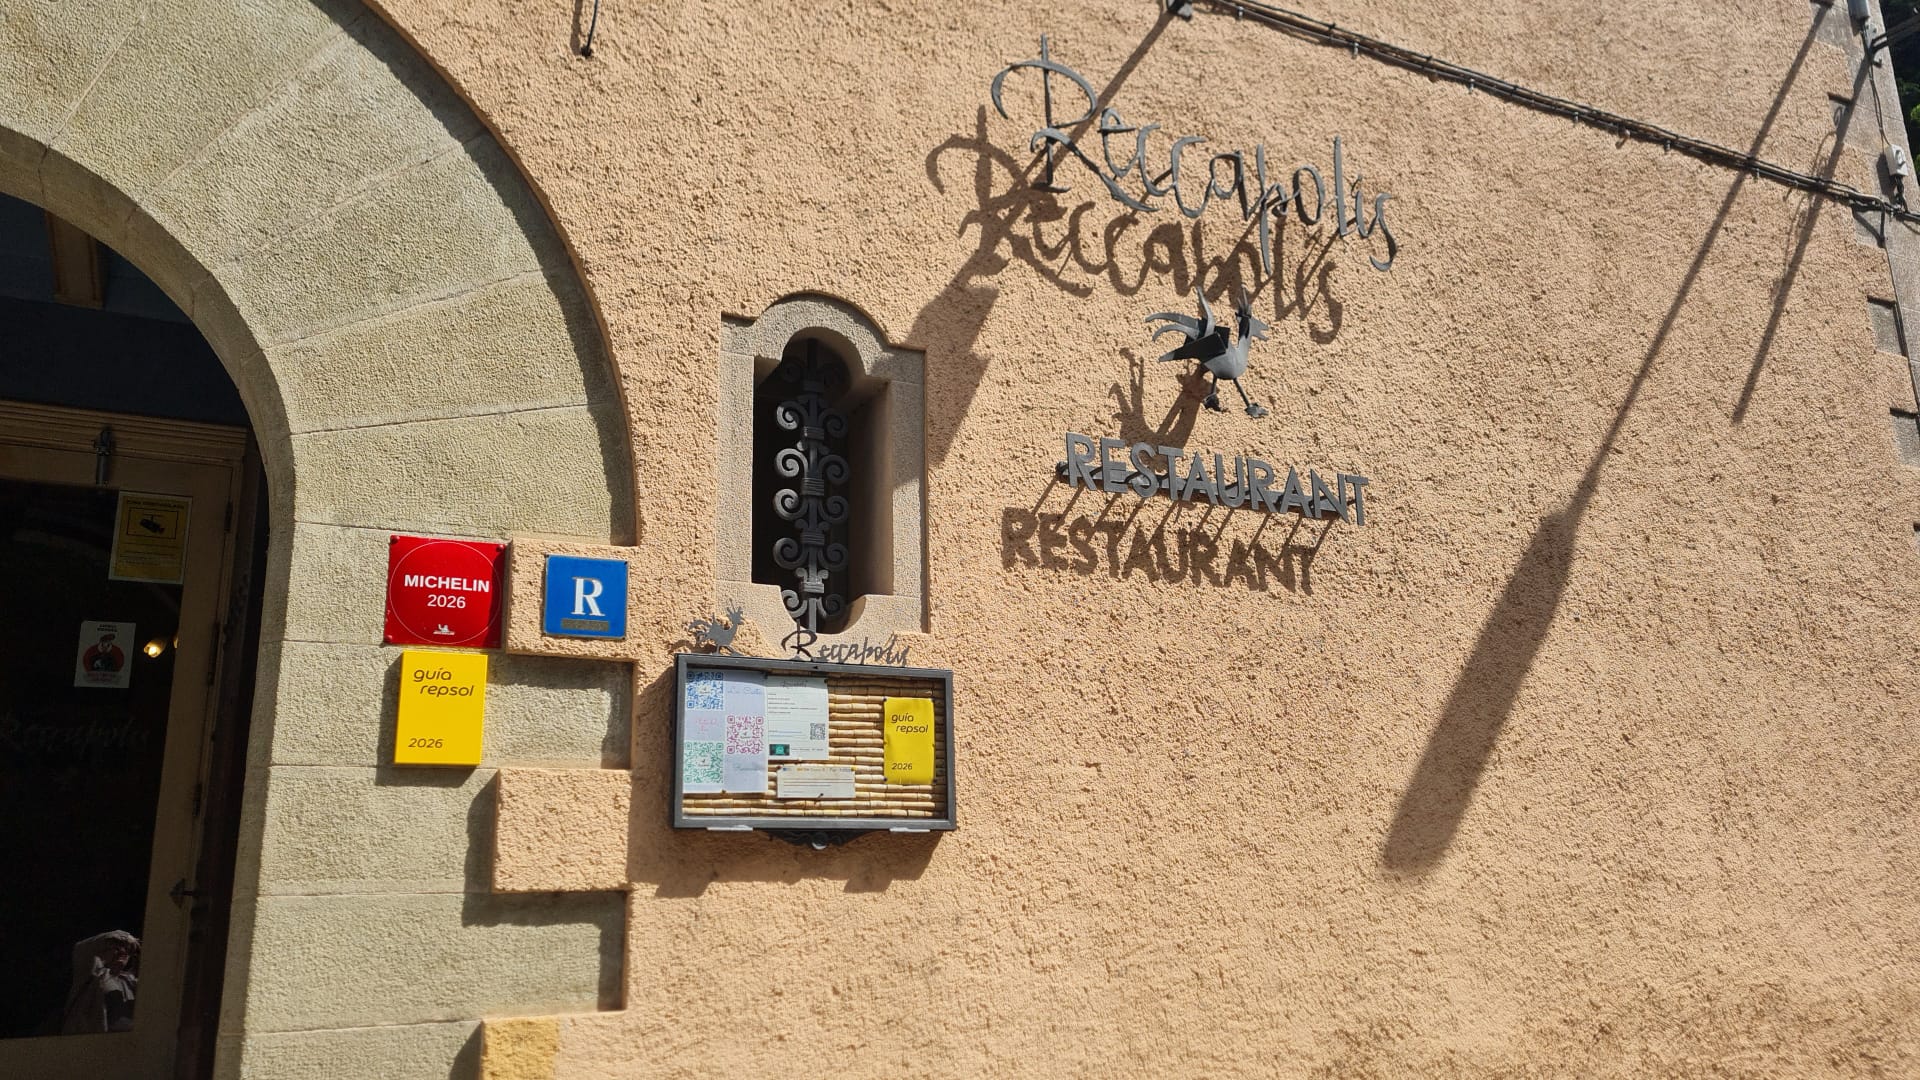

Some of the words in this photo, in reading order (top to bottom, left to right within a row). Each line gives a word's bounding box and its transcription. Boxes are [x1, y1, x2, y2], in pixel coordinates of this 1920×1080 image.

[991, 33, 1398, 271] Reccapolis
[1066, 433, 1369, 526] RESTAURANT
[404, 574, 490, 593] MICHELIN
[427, 594, 467, 609] 2026
[571, 576, 606, 617] R
[413, 667, 453, 683] guía
[419, 684, 475, 698] repsol
[891, 712, 914, 724] guía
[895, 724, 929, 735] repsol
[408, 738, 444, 749] 2026
[891, 762, 913, 771] 2026
